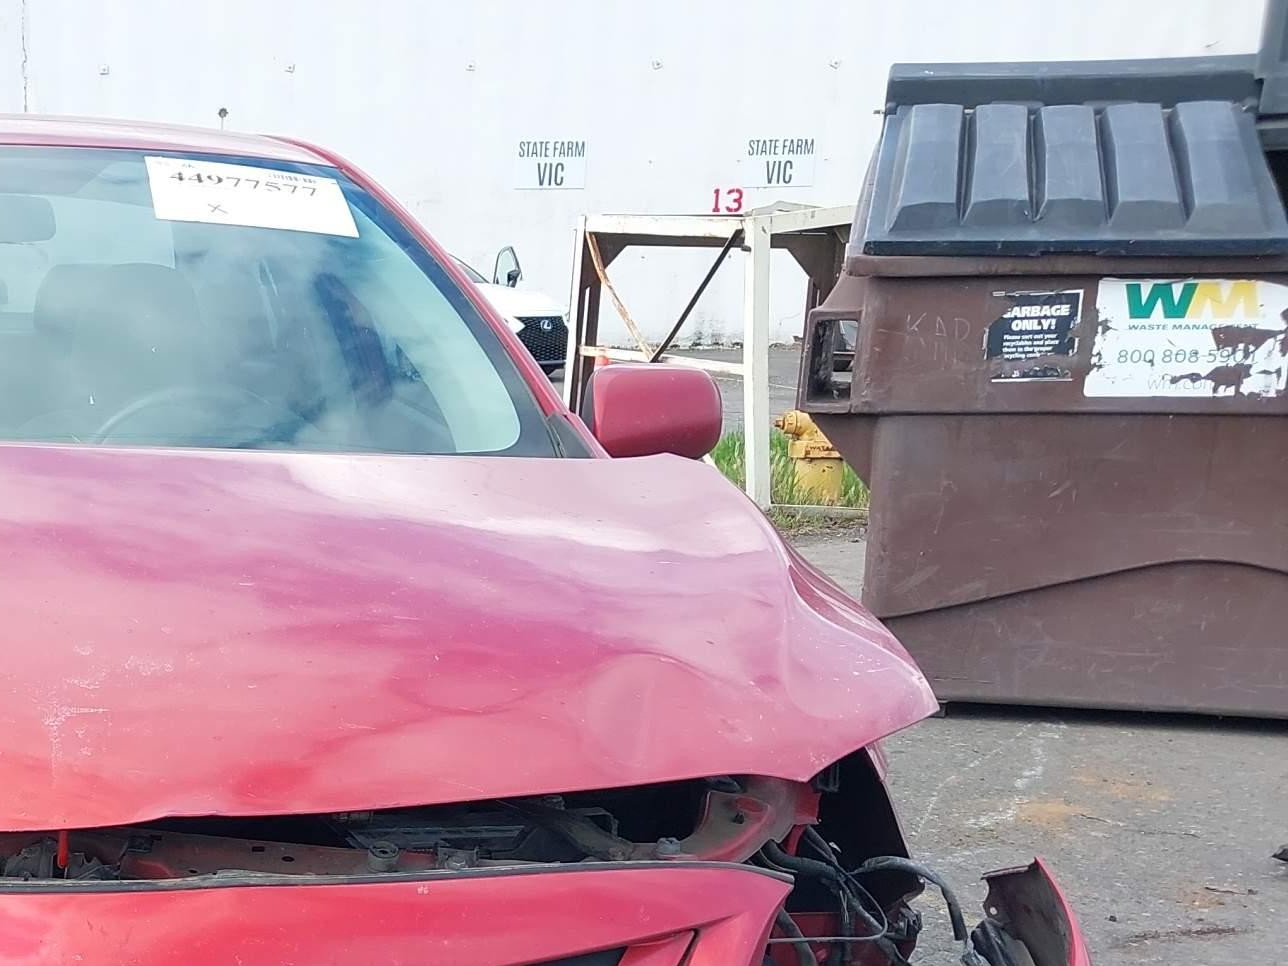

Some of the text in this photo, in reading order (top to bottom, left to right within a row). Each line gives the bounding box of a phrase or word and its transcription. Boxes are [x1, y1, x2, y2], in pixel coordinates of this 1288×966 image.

[518, 140, 586, 158] STATE FARM
[748, 138, 815, 156] STATE FARM
[537, 162, 565, 187] VIC
[766, 160, 793, 185] VIC
[169, 171, 317, 197] 44977577
[712, 187, 744, 213] 13
[1125, 282, 1259, 319] WM
[1011, 319, 1057, 331] ONLY!
[1128, 323, 1258, 331] WASTE MANAGEENT
[1117, 349, 1155, 364] 800
